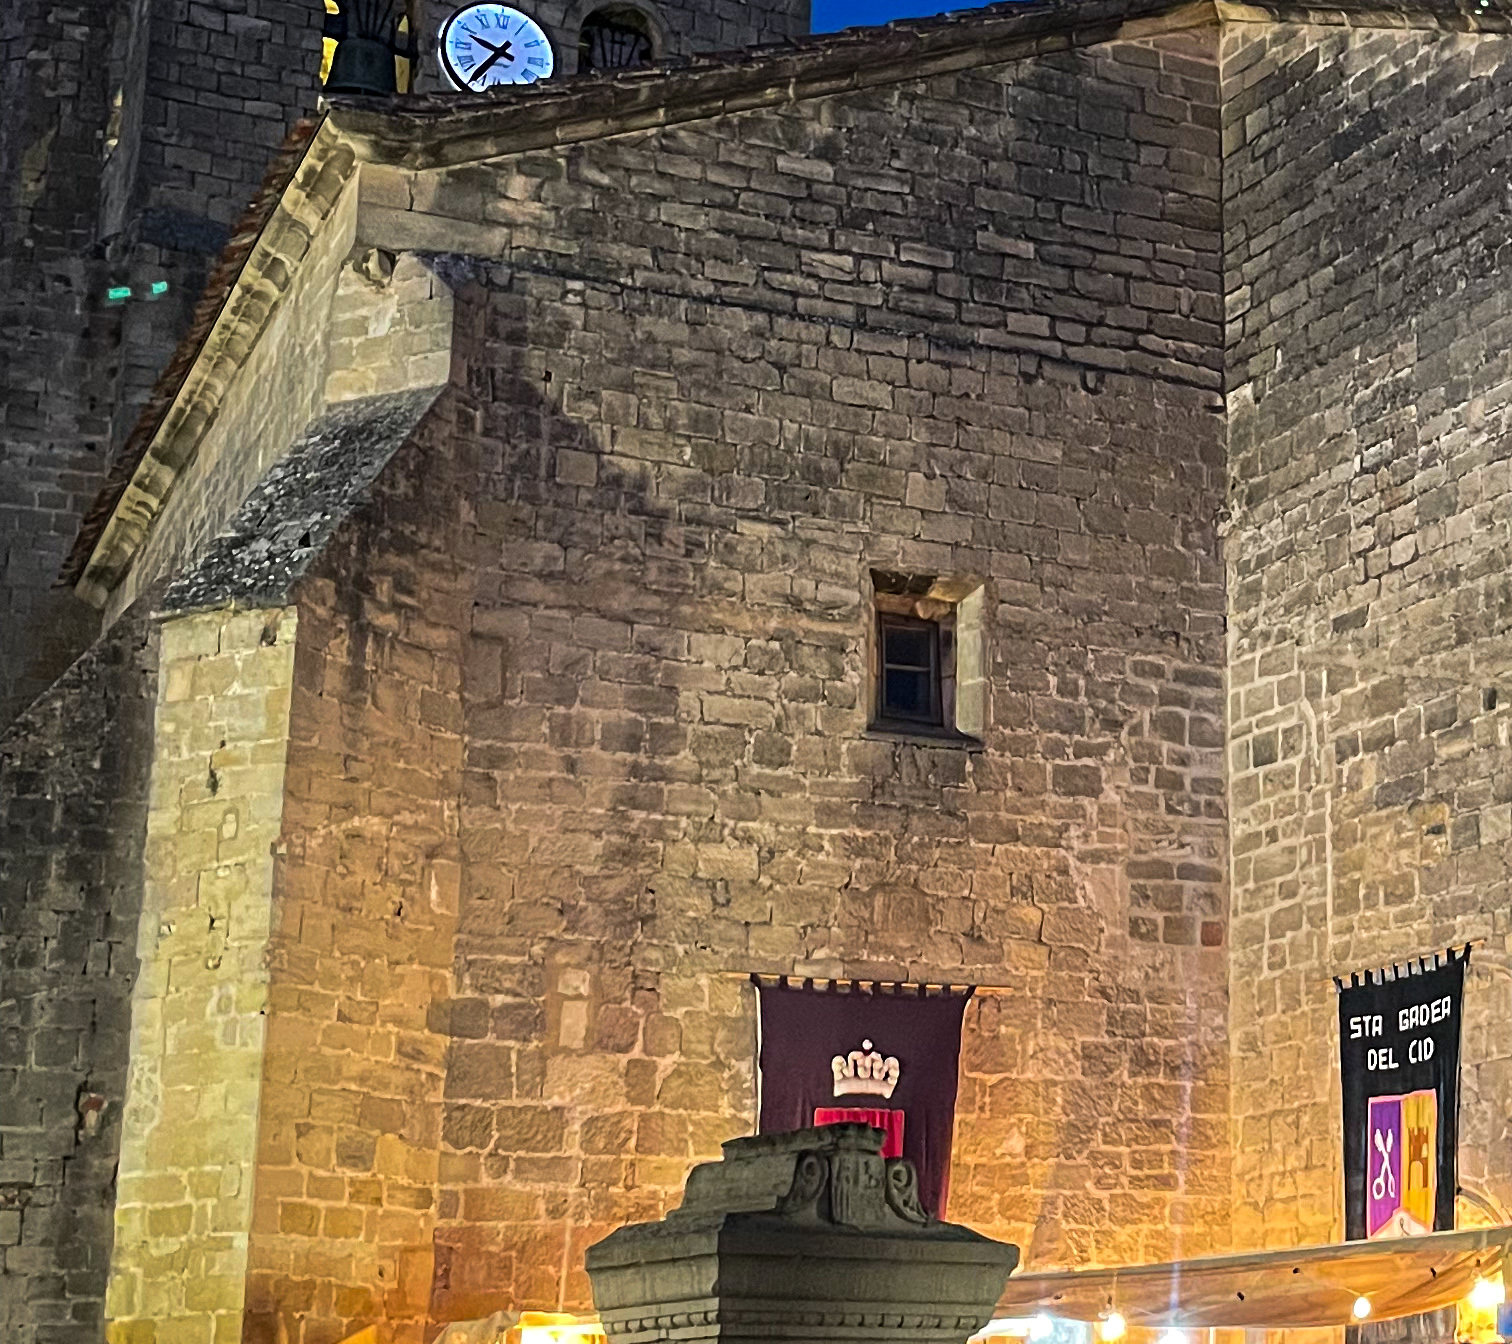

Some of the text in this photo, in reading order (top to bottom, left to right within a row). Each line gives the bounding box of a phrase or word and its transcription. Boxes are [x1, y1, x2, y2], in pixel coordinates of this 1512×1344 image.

[1350, 996, 1451, 1039] STA GADEA
[1368, 1037, 1434, 1070] DEL CID
